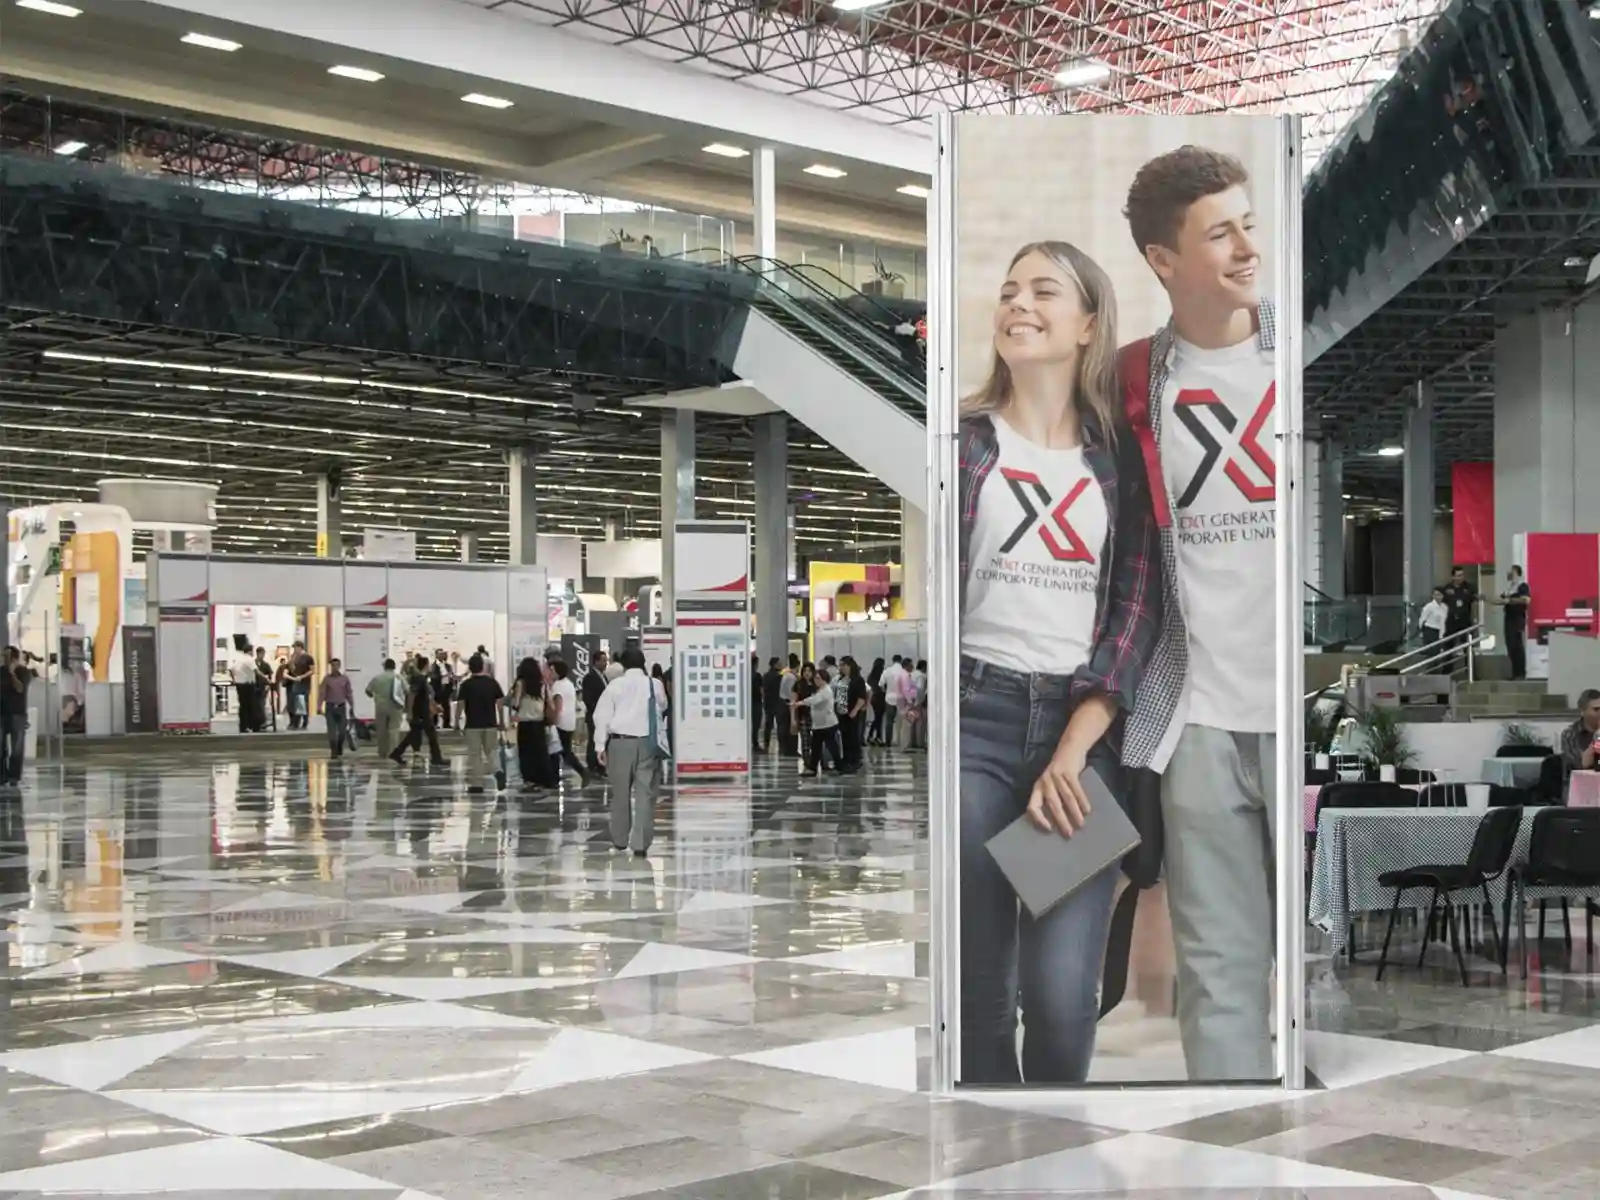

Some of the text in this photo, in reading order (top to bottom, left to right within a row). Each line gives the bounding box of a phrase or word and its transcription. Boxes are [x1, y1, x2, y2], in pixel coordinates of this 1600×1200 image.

[1180, 514, 1206, 529] EXT
[1179, 529, 1237, 545] PORATE
[976, 568, 1041, 588] CORPORATE
[1022, 562, 1098, 580] GENERATION
[571, 641, 590, 692] elcel
[130, 649, 141, 723] Bienvenidos
